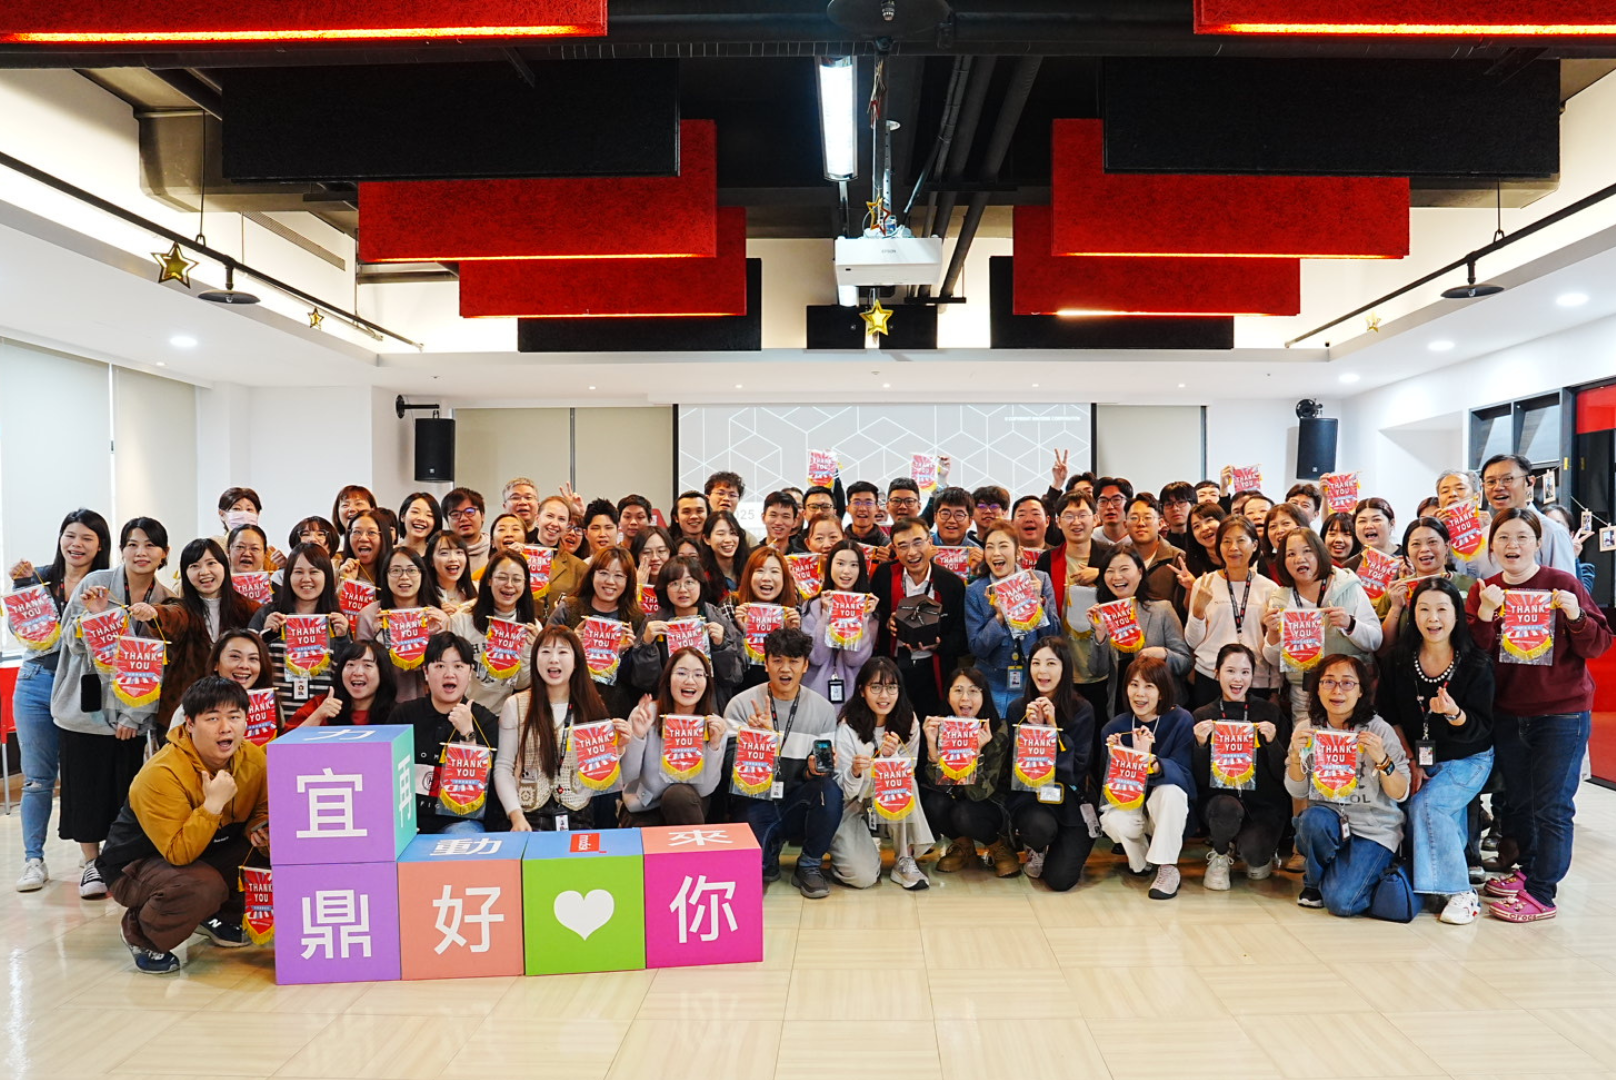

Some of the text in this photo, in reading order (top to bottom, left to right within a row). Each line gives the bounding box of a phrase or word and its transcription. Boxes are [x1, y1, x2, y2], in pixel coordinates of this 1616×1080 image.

[1236, 475, 1257, 483] THANK
[1450, 512, 1473, 526] THANK
[1457, 522, 1471, 532] YOU
[940, 556, 966, 564] THANK
[1366, 561, 1391, 574] THANK
[1367, 569, 1384, 579] YOU
[237, 583, 265, 592] THANK
[1002, 582, 1028, 598] THANK
[344, 592, 369, 603] THANK
[1010, 592, 1025, 603] YOU
[12, 598, 46, 614] THANK
[348, 601, 362, 609] YOU
[836, 602, 861, 610] THANK
[1511, 605, 1545, 613] THANK
[22, 608, 42, 619] YOU
[1517, 614, 1538, 622] YOU
[1115, 616, 1129, 626] YOU
[1288, 621, 1317, 629] THANK
[91, 621, 123, 638] THANK
[291, 626, 322, 636] THANK
[401, 630, 418, 638] YOU
[1294, 629, 1311, 637] YOU
[494, 629, 522, 641] THANK
[589, 631, 616, 639] THANK
[671, 632, 698, 641] THANK
[297, 636, 316, 644] YOU
[498, 638, 514, 648] YOU
[677, 639, 694, 647] YOU
[124, 652, 158, 661] THANK
[130, 661, 150, 670] YOU
[250, 701, 270, 713] HANK
[250, 713, 267, 722] YOU
[304, 729, 376, 741] 力
[670, 729, 699, 737] THANK
[580, 734, 610, 748] THANK
[1023, 739, 1051, 747] THANK
[1219, 734, 1249, 743] THANK
[587, 745, 605, 755] YOU
[743, 742, 771, 751] THANK
[1225, 743, 1242, 751] YOU
[1321, 745, 1352, 753] THANK
[1326, 754, 1345, 762] YOU
[451, 759, 482, 768] THANK
[1116, 760, 1143, 770] THANK
[457, 769, 475, 777] YOU
[879, 771, 907, 779] THANK
[296, 767, 368, 839] 宜
[668, 829, 733, 846] 來
[429, 837, 503, 856] 動
[254, 893, 268, 902] YOU
[669, 875, 738, 943] 你
[432, 884, 504, 955] 好
[300, 889, 373, 960] 鼎
